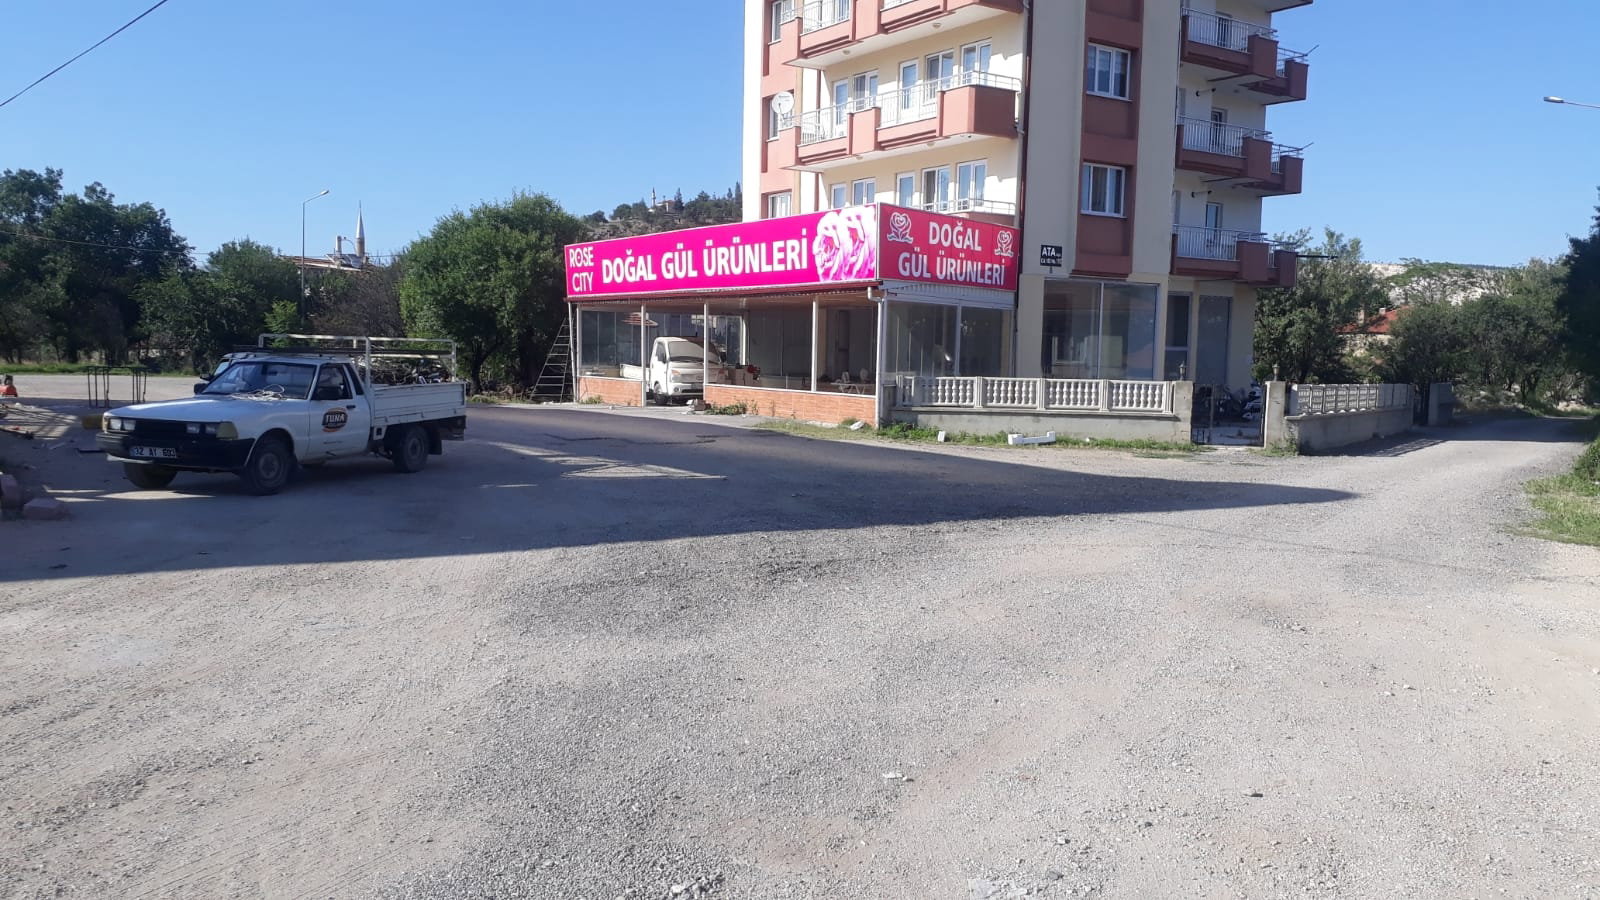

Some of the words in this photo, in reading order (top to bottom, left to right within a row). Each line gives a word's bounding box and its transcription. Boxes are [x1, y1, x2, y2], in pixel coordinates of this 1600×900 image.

[929, 220, 982, 251] DOĞAL
[569, 246, 594, 268] ROSE
[602, 249, 657, 284] DOĞAL
[661, 242, 698, 279] GÜL
[703, 227, 808, 277] ÜRÜNLERİ
[1041, 246, 1056, 257] ATA
[898, 246, 931, 279] GÜL
[936, 250, 1005, 286] ÜRÜNLERİ
[572, 271, 594, 292] CITY
